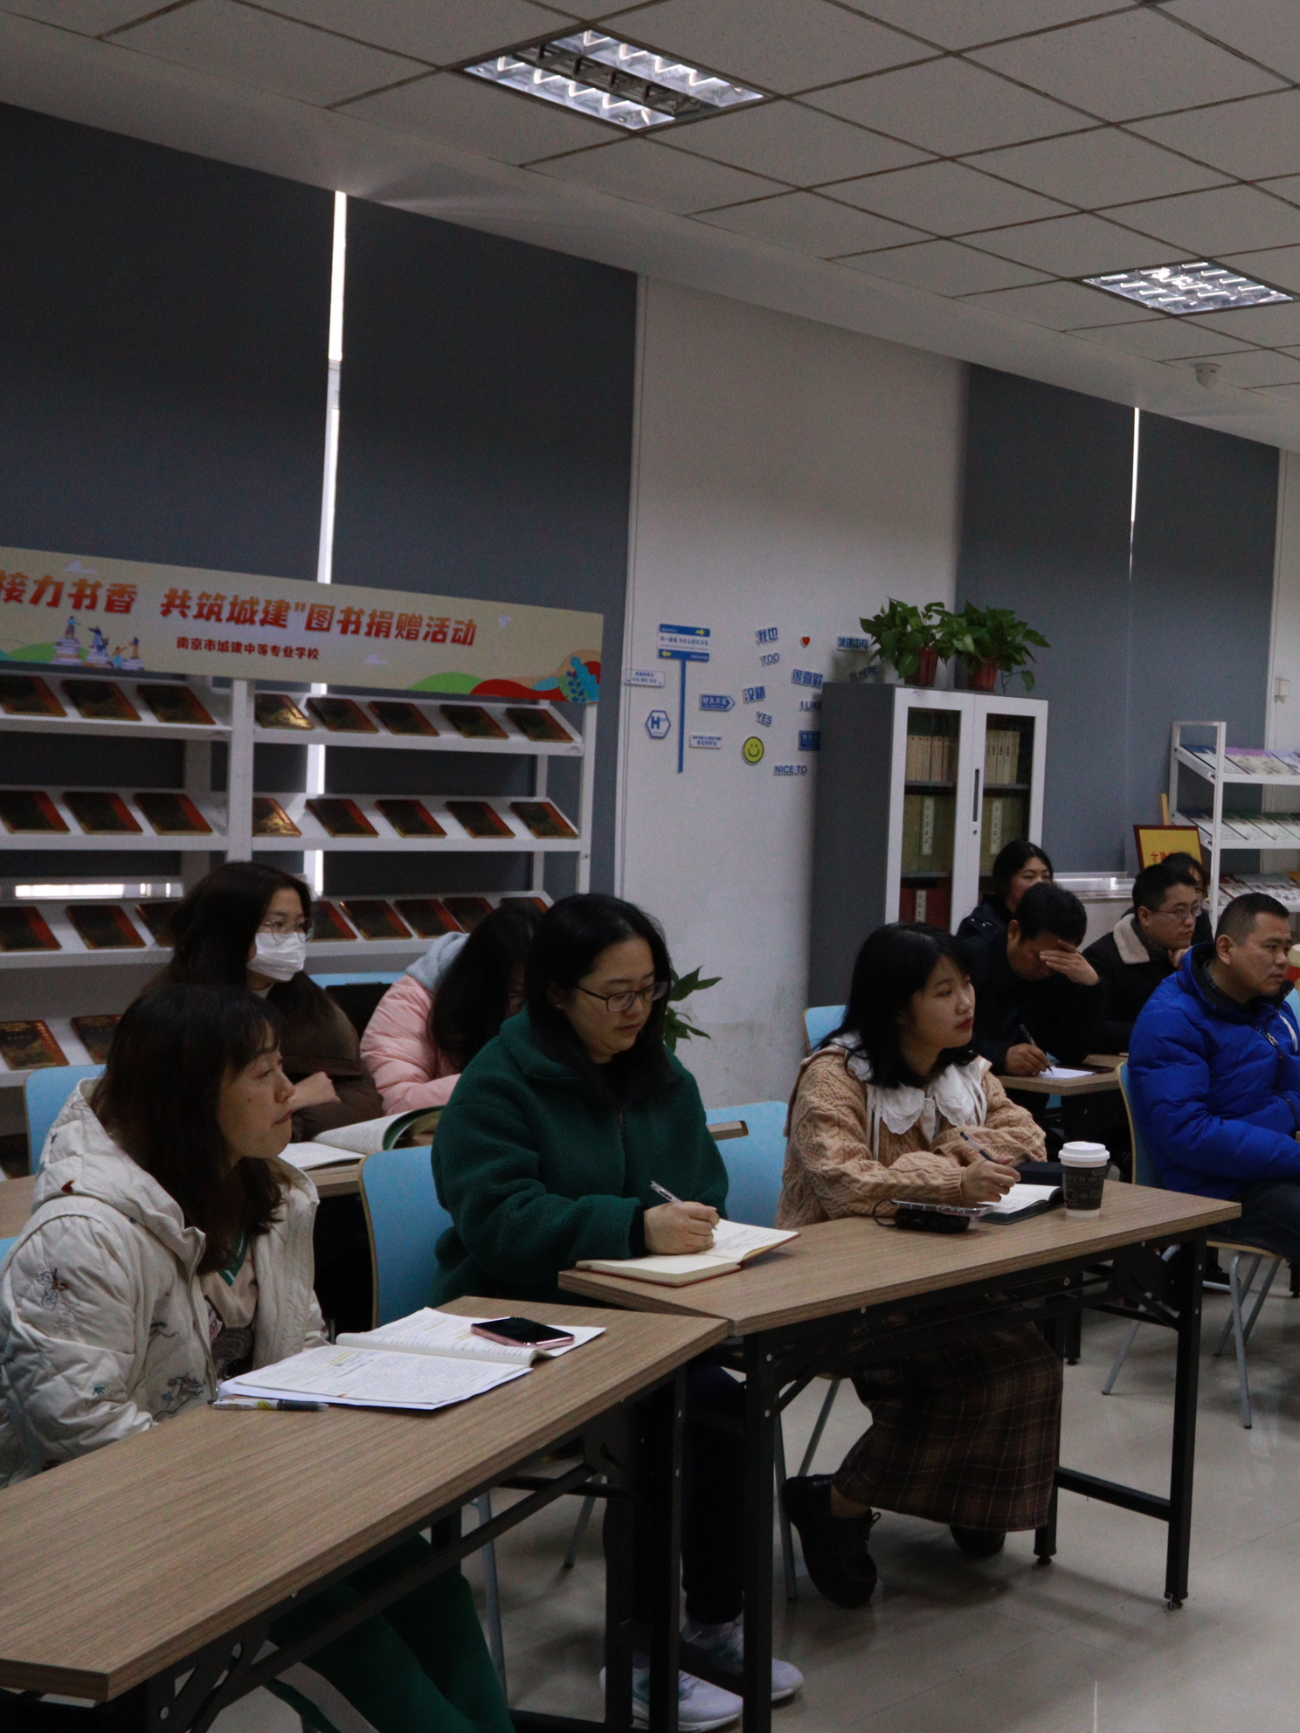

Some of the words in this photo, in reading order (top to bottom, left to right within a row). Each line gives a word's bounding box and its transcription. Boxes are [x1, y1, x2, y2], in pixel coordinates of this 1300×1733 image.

[757, 627, 779, 643] 我也
[176, 636, 320, 660] 南京市城建中等专业学校
[761, 653, 780, 665] TOO
[757, 711, 773, 725] YES
[774, 765, 794, 774] NICE
[797, 765, 807, 774] TO
